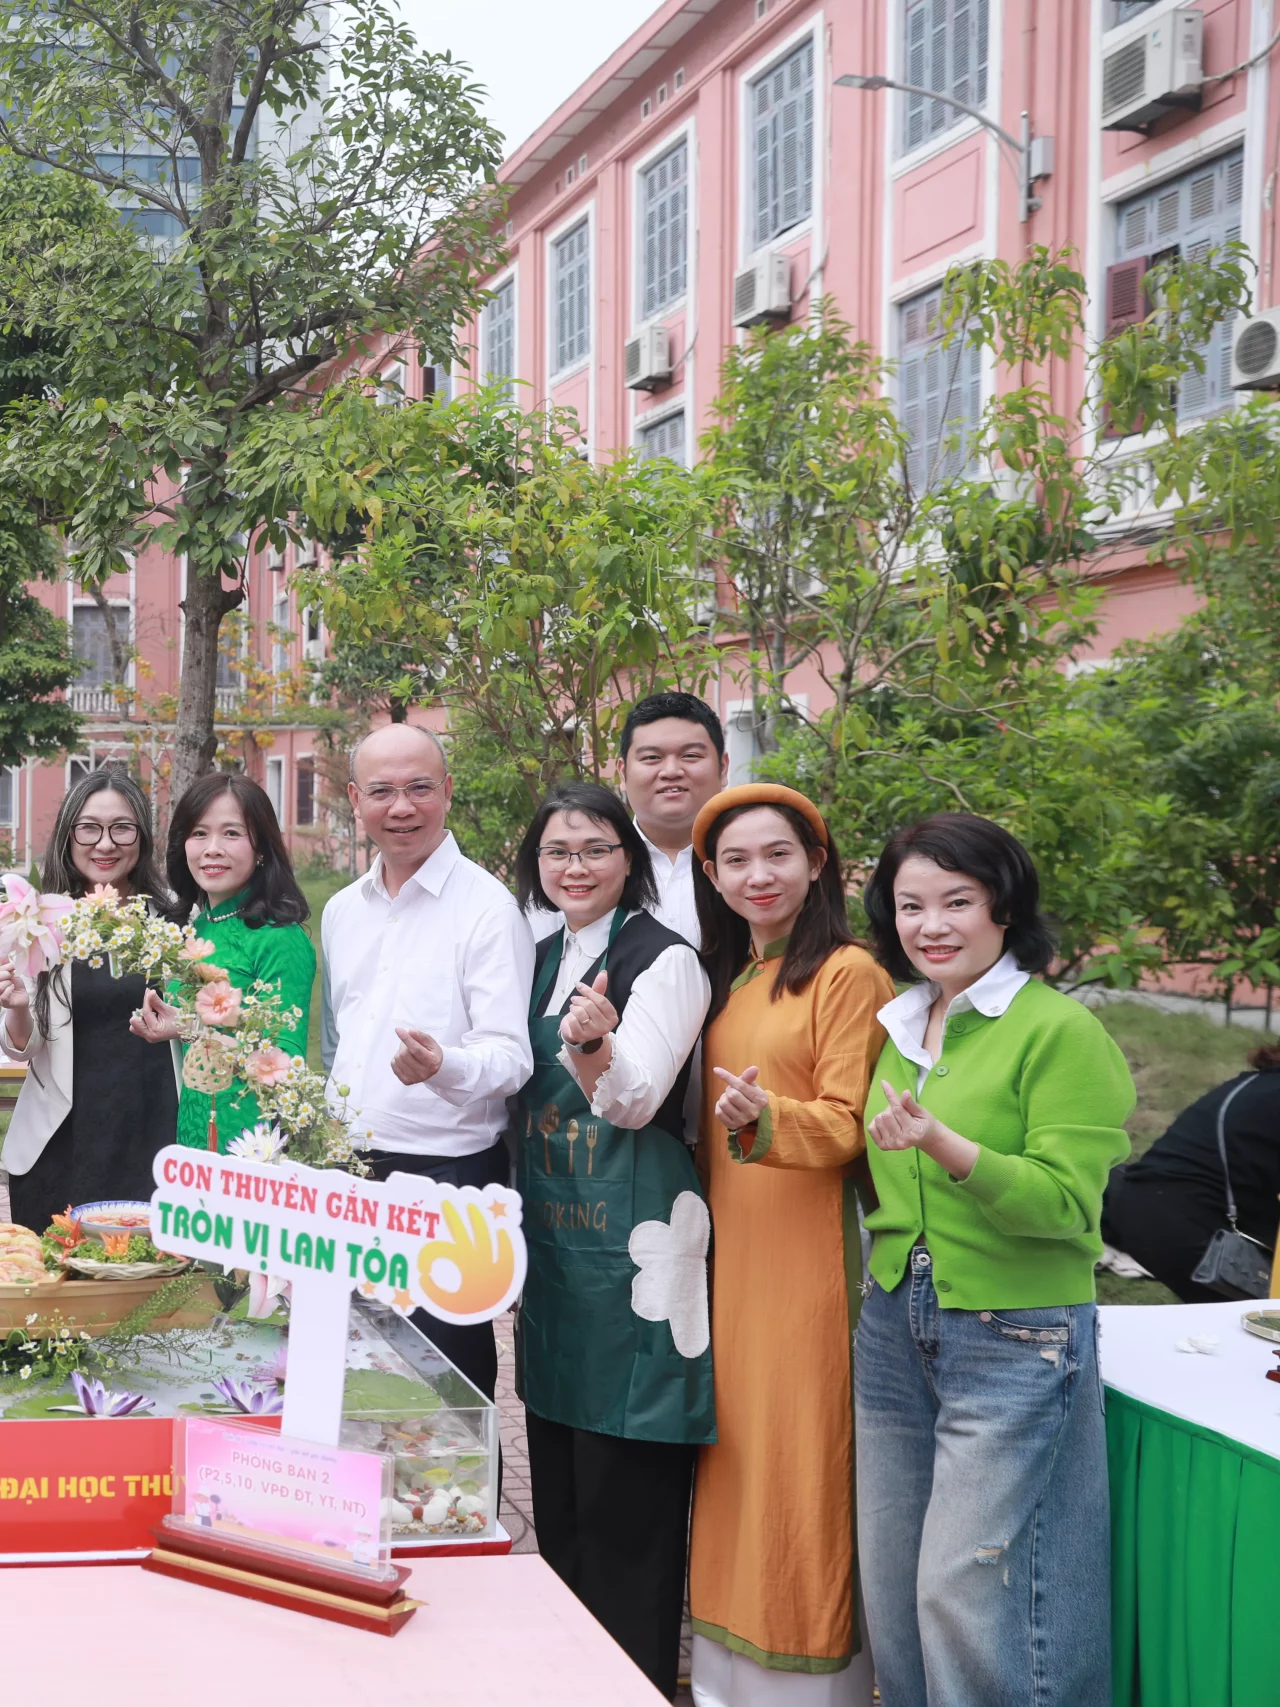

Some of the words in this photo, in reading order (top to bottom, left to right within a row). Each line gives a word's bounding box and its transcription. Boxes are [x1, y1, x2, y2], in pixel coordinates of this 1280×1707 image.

[163, 1157, 212, 1192] CON
[220, 1169, 318, 1214] THUYỀN
[326, 1185, 379, 1226] GẮN
[387, 1199, 440, 1239] KẾT
[158, 1198, 233, 1250] TRÒN
[243, 1219, 269, 1271] VỊ
[280, 1227, 336, 1273] LAN
[346, 1236, 409, 1290] TỎA
[58, 1474, 115, 1505] HỌC
[232, 1451, 282, 1474] PHÒNG
[288, 1461, 317, 1481] BAN
[322, 1471, 330, 1485] 2
